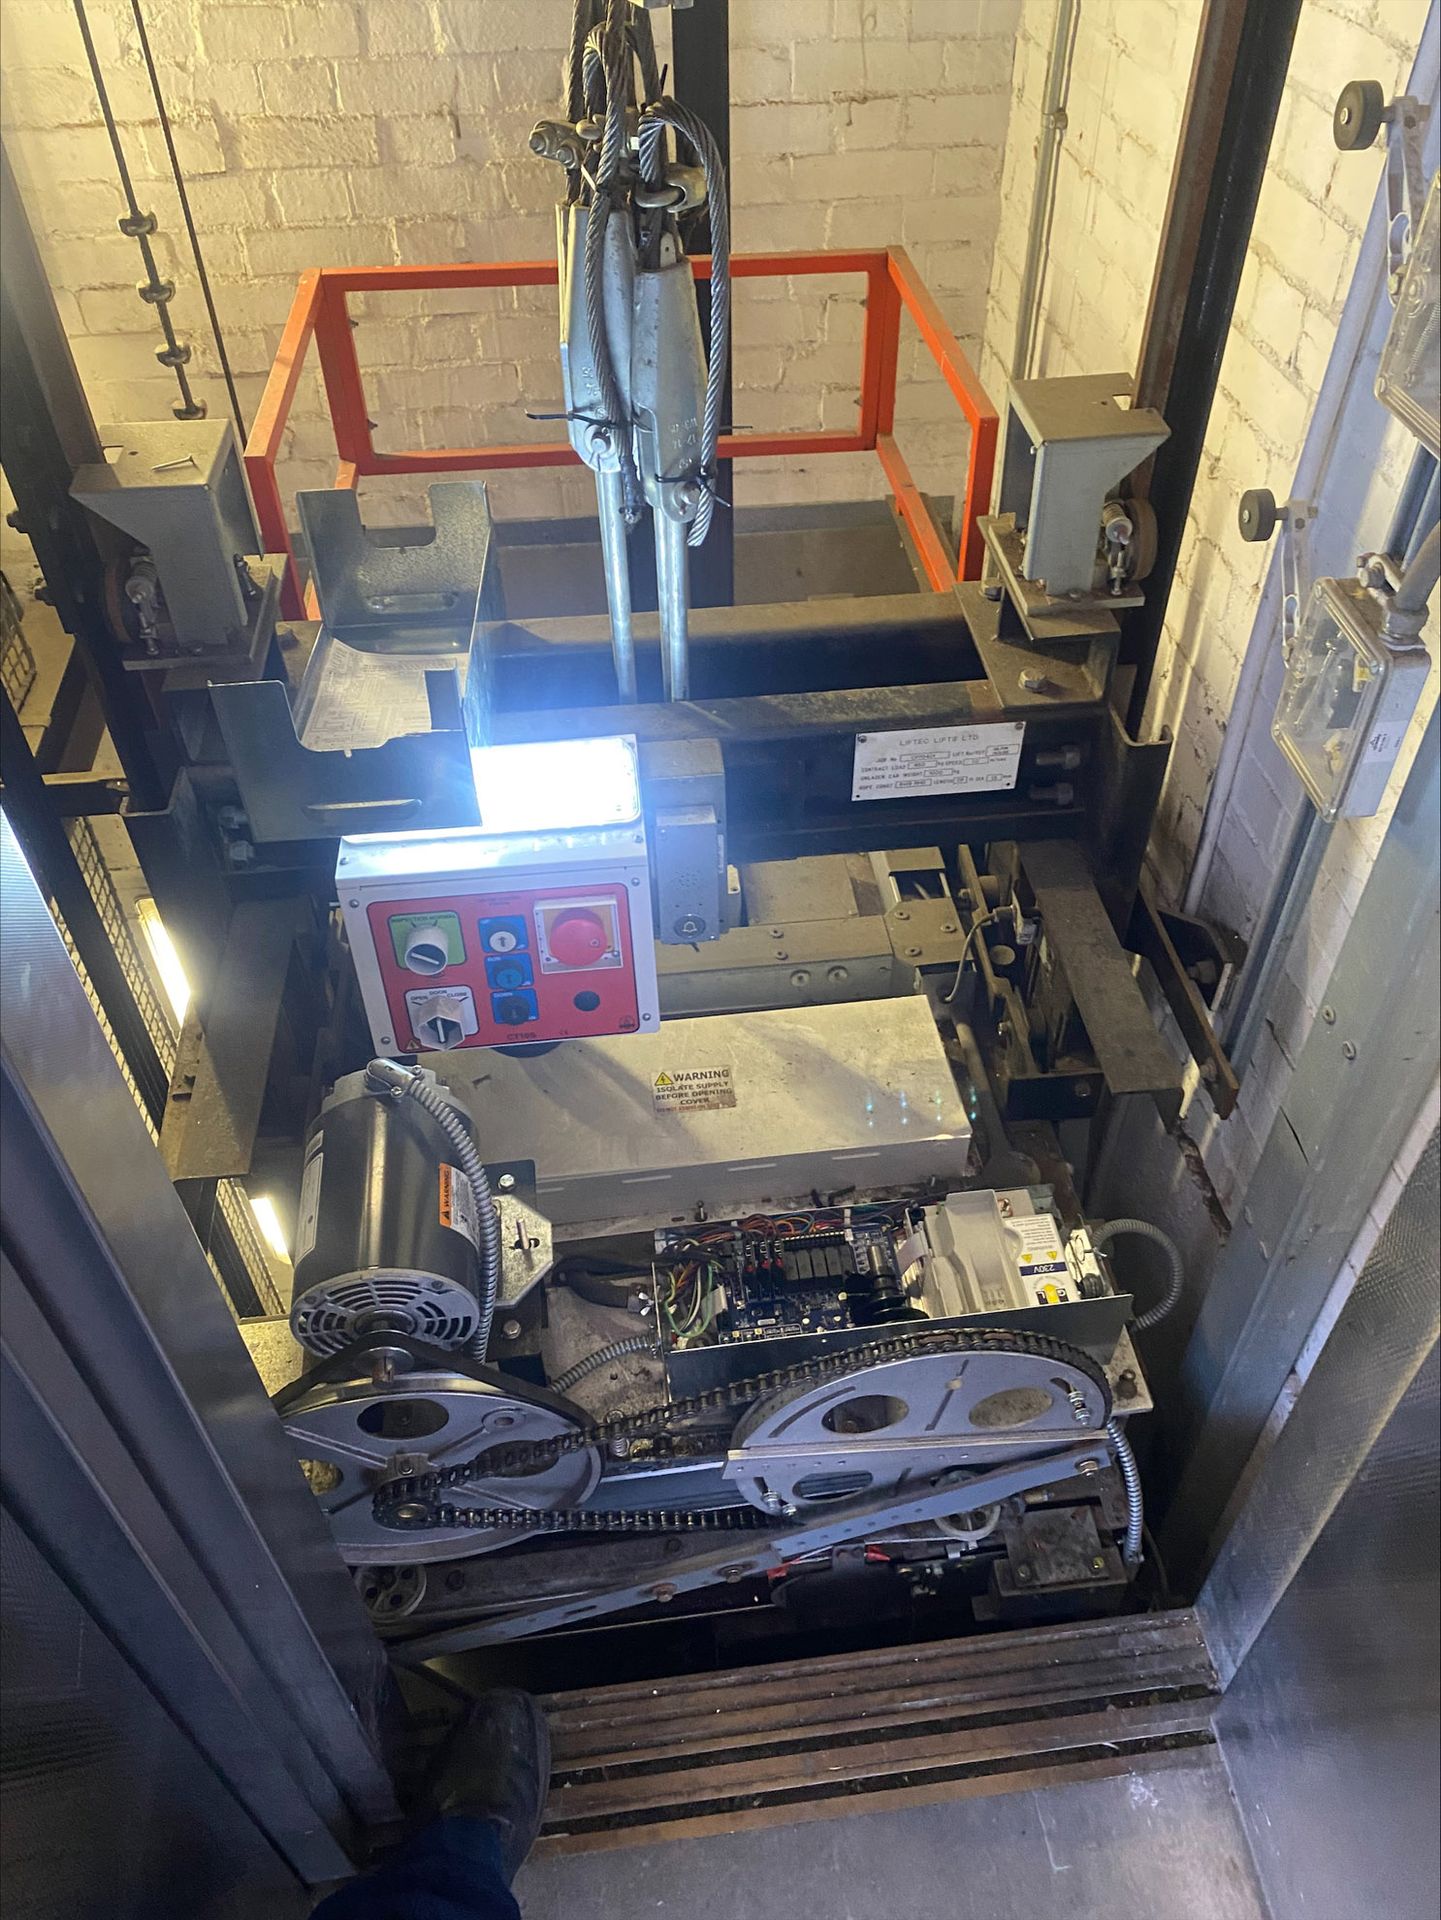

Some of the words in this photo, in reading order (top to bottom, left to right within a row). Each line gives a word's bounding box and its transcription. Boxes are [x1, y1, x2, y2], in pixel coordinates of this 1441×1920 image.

[673, 1069, 730, 1082] WARNING
[657, 1084, 694, 1093] ISOLATE
[696, 1081, 729, 1090] SUPPLY
[655, 1092, 689, 1100] BEFORE
[692, 1087, 733, 1097] OPENING
[680, 1097, 710, 1105] COVER
[1033, 1264, 1055, 1273] 230V
